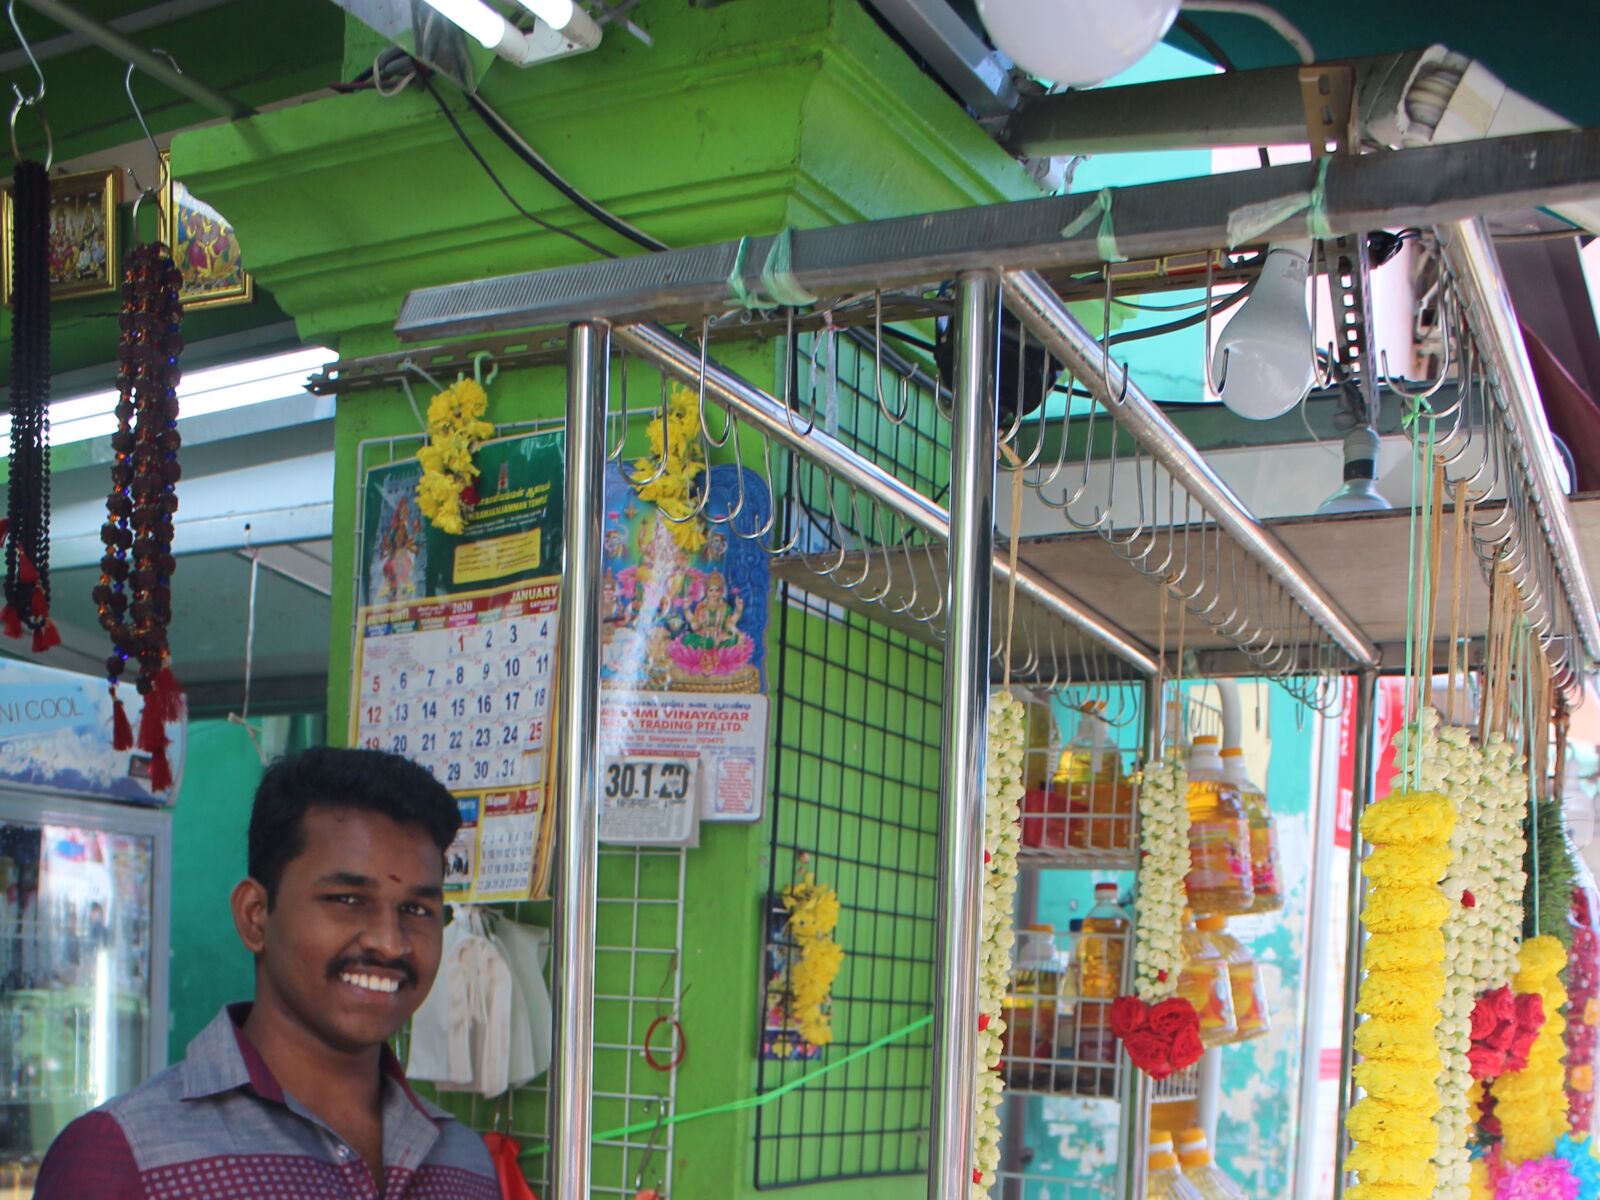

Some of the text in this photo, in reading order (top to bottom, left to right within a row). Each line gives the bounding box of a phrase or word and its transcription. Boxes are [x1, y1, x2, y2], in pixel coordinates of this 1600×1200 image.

[511, 585, 559, 603] JANUARY
[452, 601, 473, 613] 2020
[458, 620, 548, 652] 1 2 3 4
[372, 654, 549, 693] 5 6 7 8 9 10 11
[367, 688, 545, 724] 12 13 14 15 16 17 18
[663, 709, 750, 722] VINAYAGAR
[639, 719, 693, 730] TRADING
[365, 721, 543, 754] 19 20 21 22 23 24 25
[448, 763, 461, 781] 29
[474, 760, 489, 780] 30
[502, 758, 515, 778] 31
